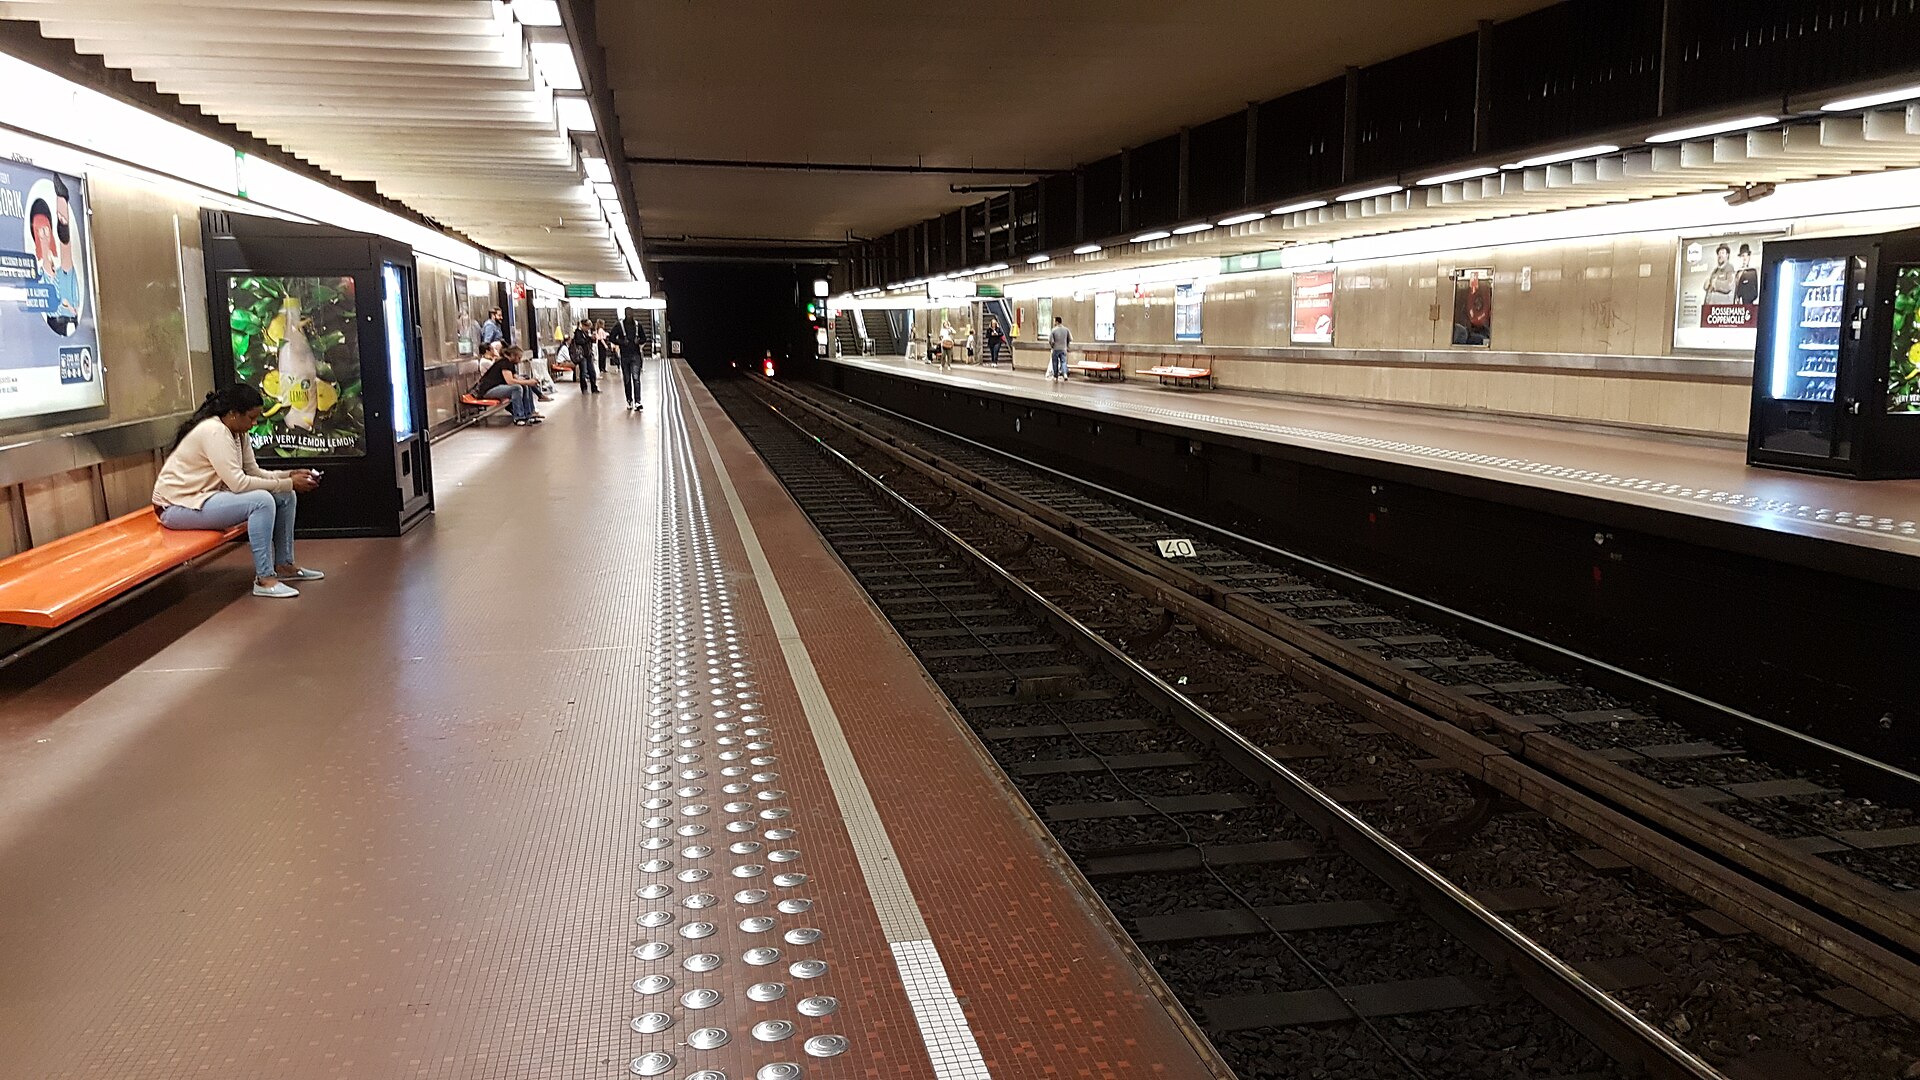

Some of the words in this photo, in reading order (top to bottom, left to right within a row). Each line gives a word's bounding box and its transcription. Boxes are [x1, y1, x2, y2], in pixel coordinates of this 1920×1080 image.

[0, 188, 25, 218] ORIK
[1711, 307, 1745, 316] BOSSEMANS
[1707, 315, 1745, 324] COPPENOLLE
[289, 391, 309, 402] LEMON
[276, 434, 297, 444] VERY
[298, 436, 326, 448] LEMON
[1165, 541, 1192, 557] 40
